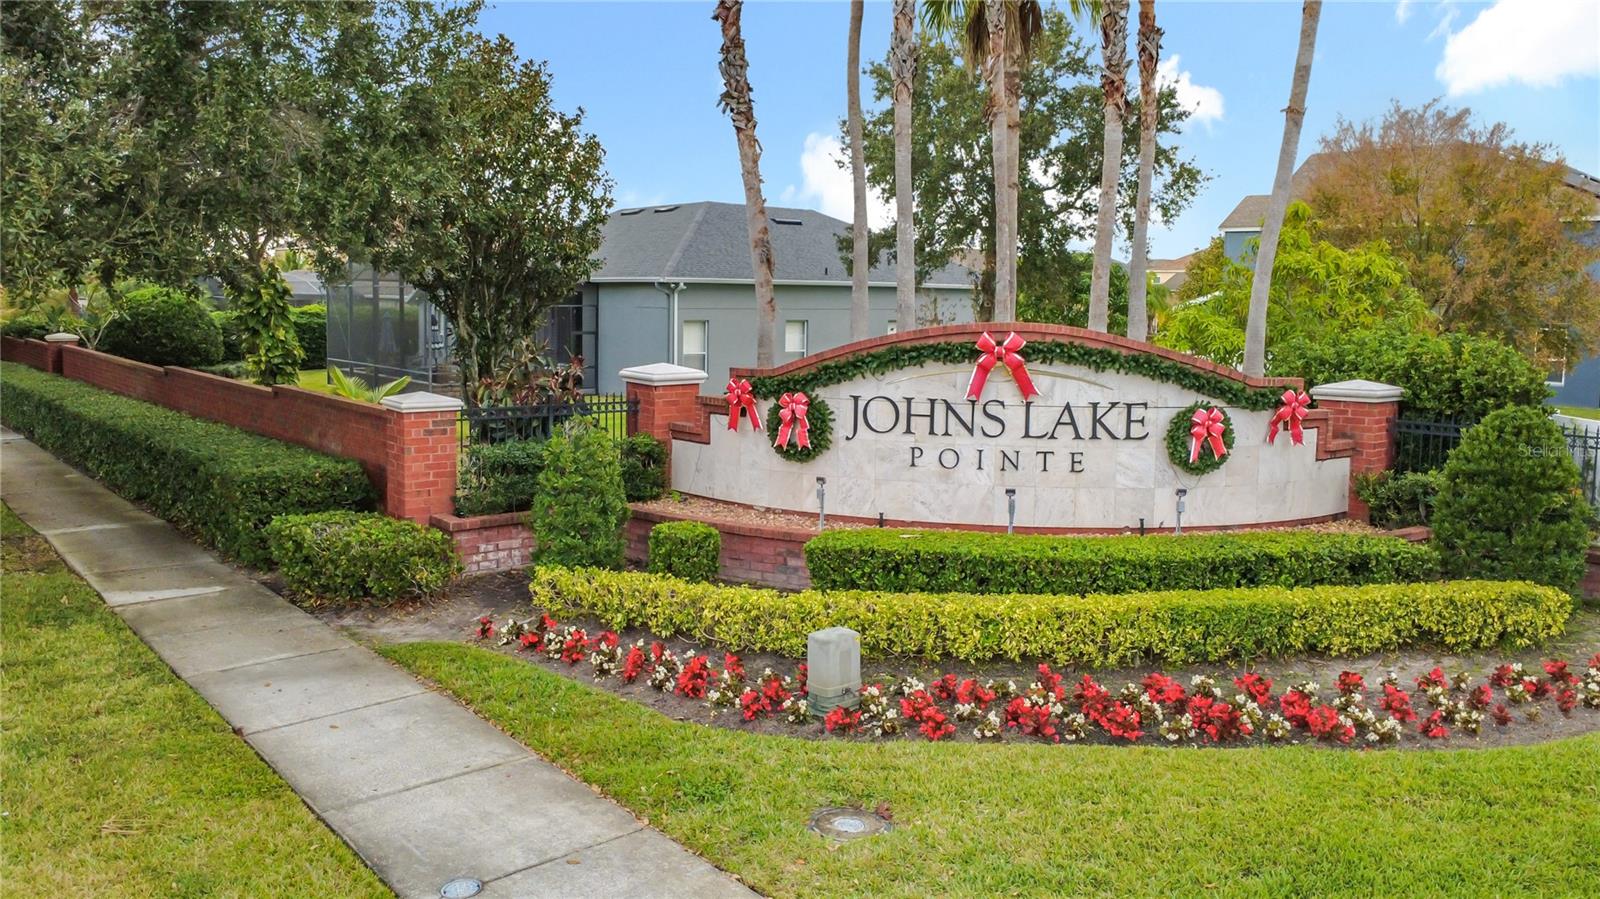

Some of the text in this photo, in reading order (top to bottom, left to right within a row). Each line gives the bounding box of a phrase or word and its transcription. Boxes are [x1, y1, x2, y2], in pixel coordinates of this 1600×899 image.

[846, 395, 1149, 440] JOHNS LAKE
[910, 446, 1085, 473] POINTE
